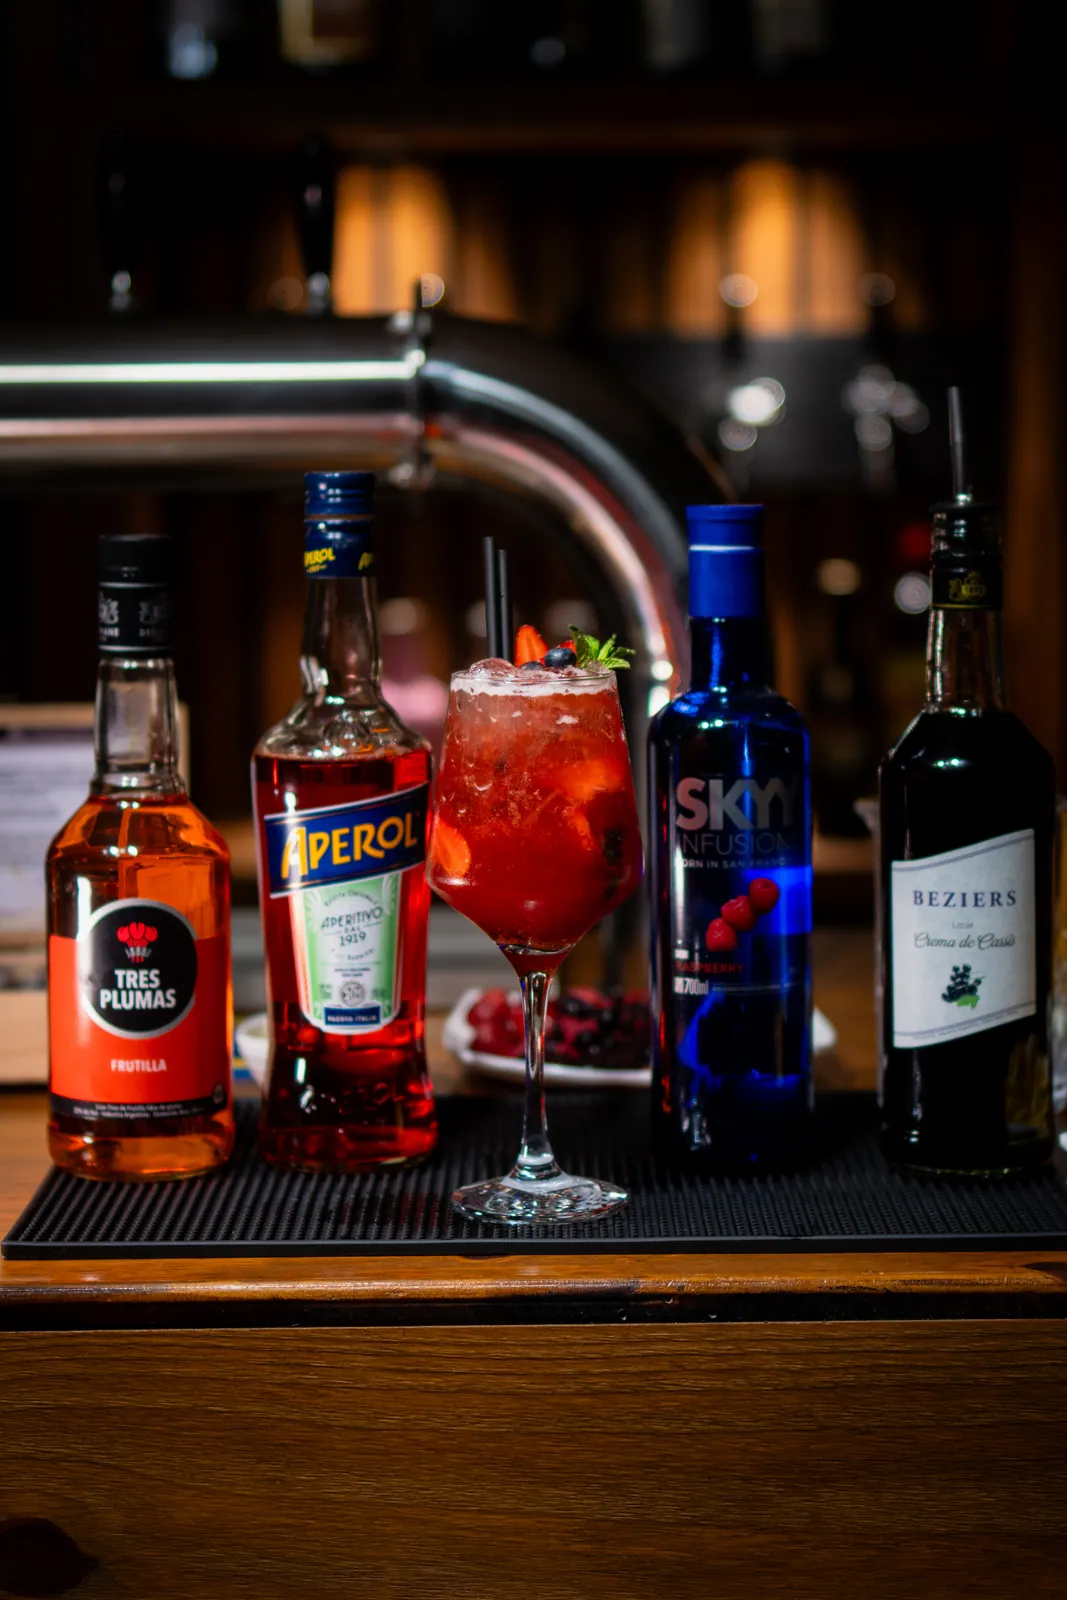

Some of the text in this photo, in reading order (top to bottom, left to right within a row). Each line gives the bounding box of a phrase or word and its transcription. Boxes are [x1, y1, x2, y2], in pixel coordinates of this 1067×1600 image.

[675, 775, 799, 831] SKYY
[281, 812, 417, 880] APEROL
[676, 858, 704, 869] ORN
[913, 890, 1016, 908] BEZIERS
[321, 906, 383, 930] APERITIVO
[339, 931, 367, 947] 1919
[914, 932, 957, 948] Crema
[959, 934, 976, 948] de
[114, 969, 161, 989] TRES
[683, 977, 709, 995] 700ml
[100, 988, 177, 1010] PLUMAS
[110, 1059, 167, 1072] FRUTILLA
